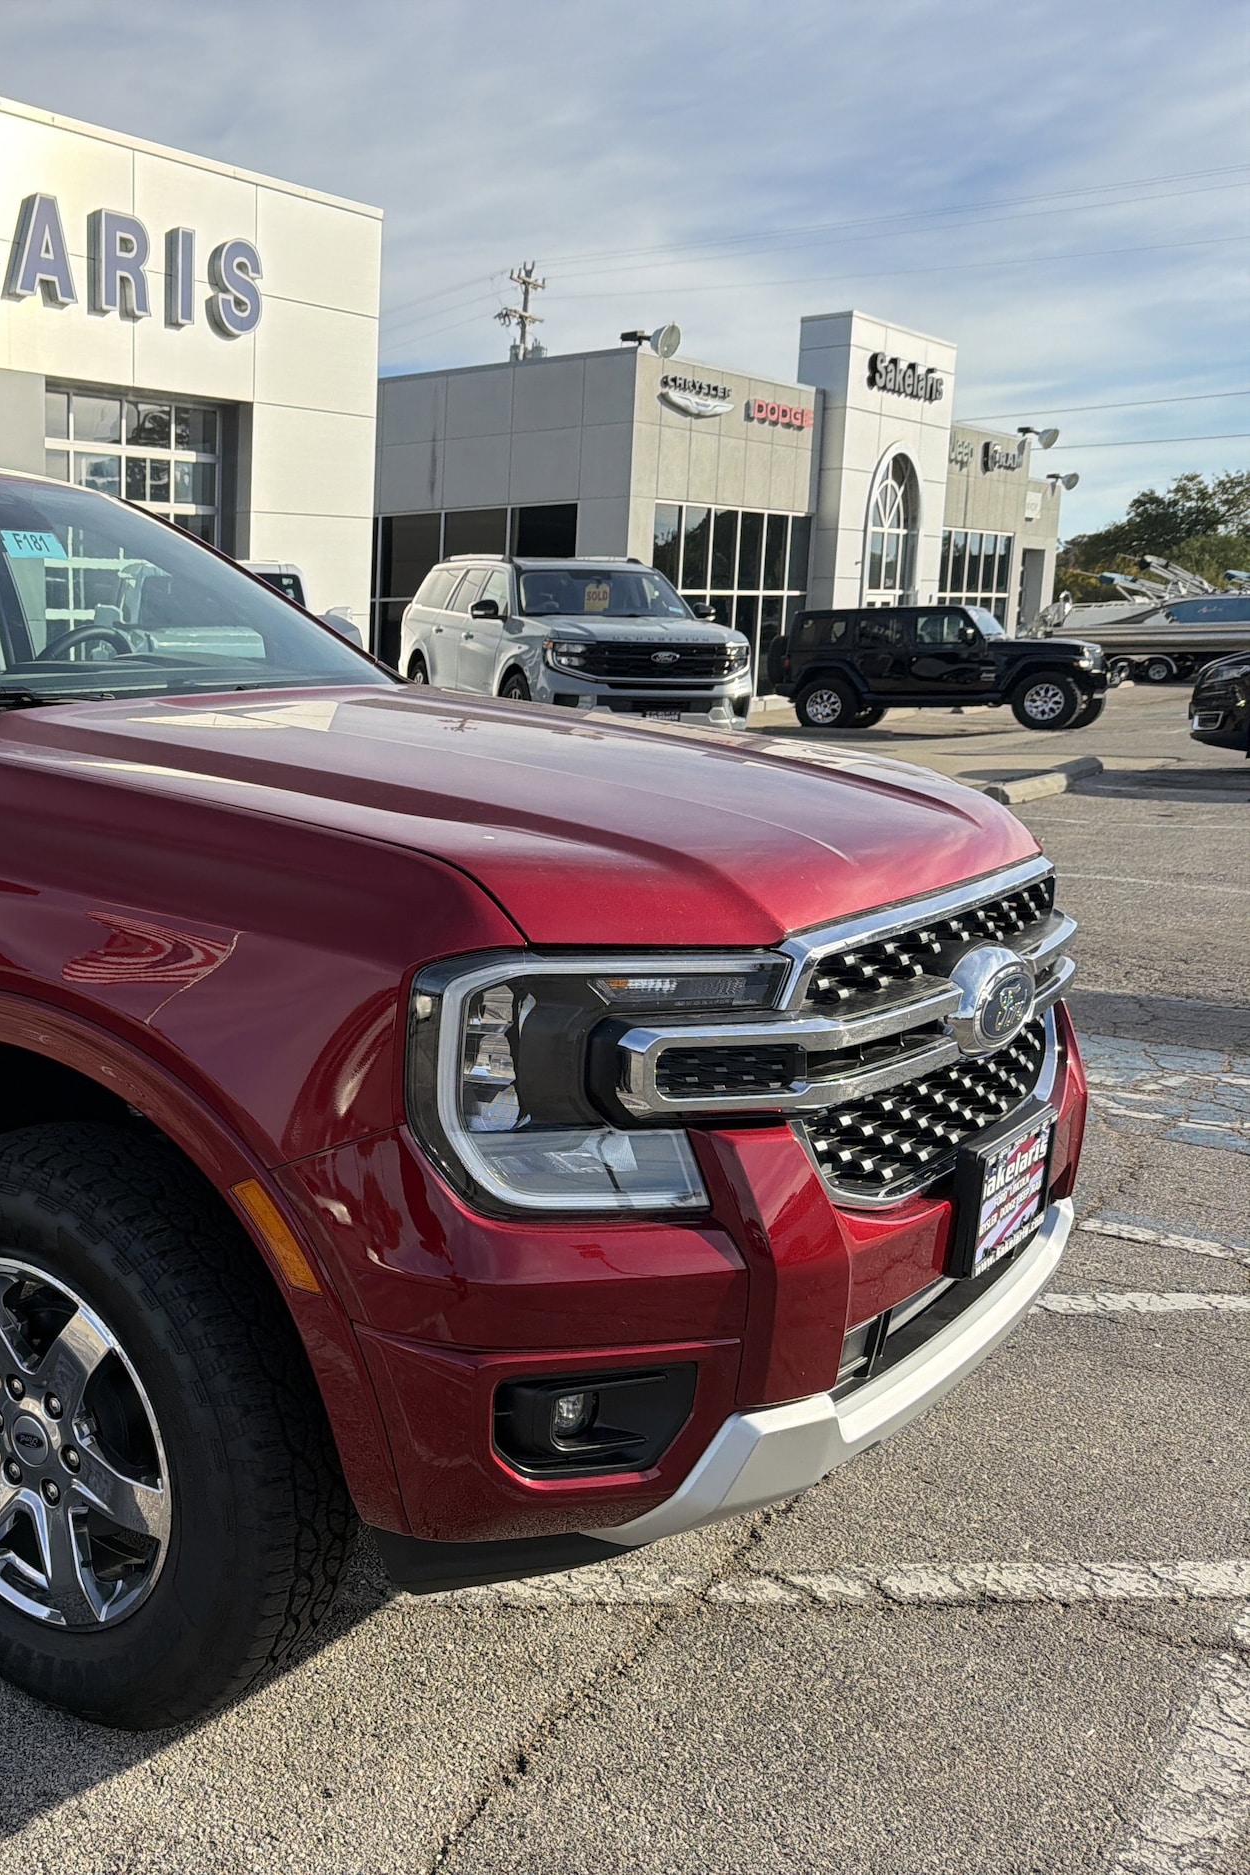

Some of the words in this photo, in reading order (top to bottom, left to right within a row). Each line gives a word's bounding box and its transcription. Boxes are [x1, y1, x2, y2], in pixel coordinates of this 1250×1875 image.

[665, 376, 732, 399] CHRYSLER
[870, 352, 944, 402] Sakelaris
[752, 398, 814, 428] DODGE
[12, 533, 50, 552] F181
[586, 591, 608, 601] SOLD
[994, 1189, 1008, 1207] FORD
[1010, 1172, 1031, 1197] LINCOLN
[979, 1212, 998, 1237] RYSLER
[1000, 1199, 1016, 1219] DODGE
[1017, 1187, 1030, 1204] JEEP
